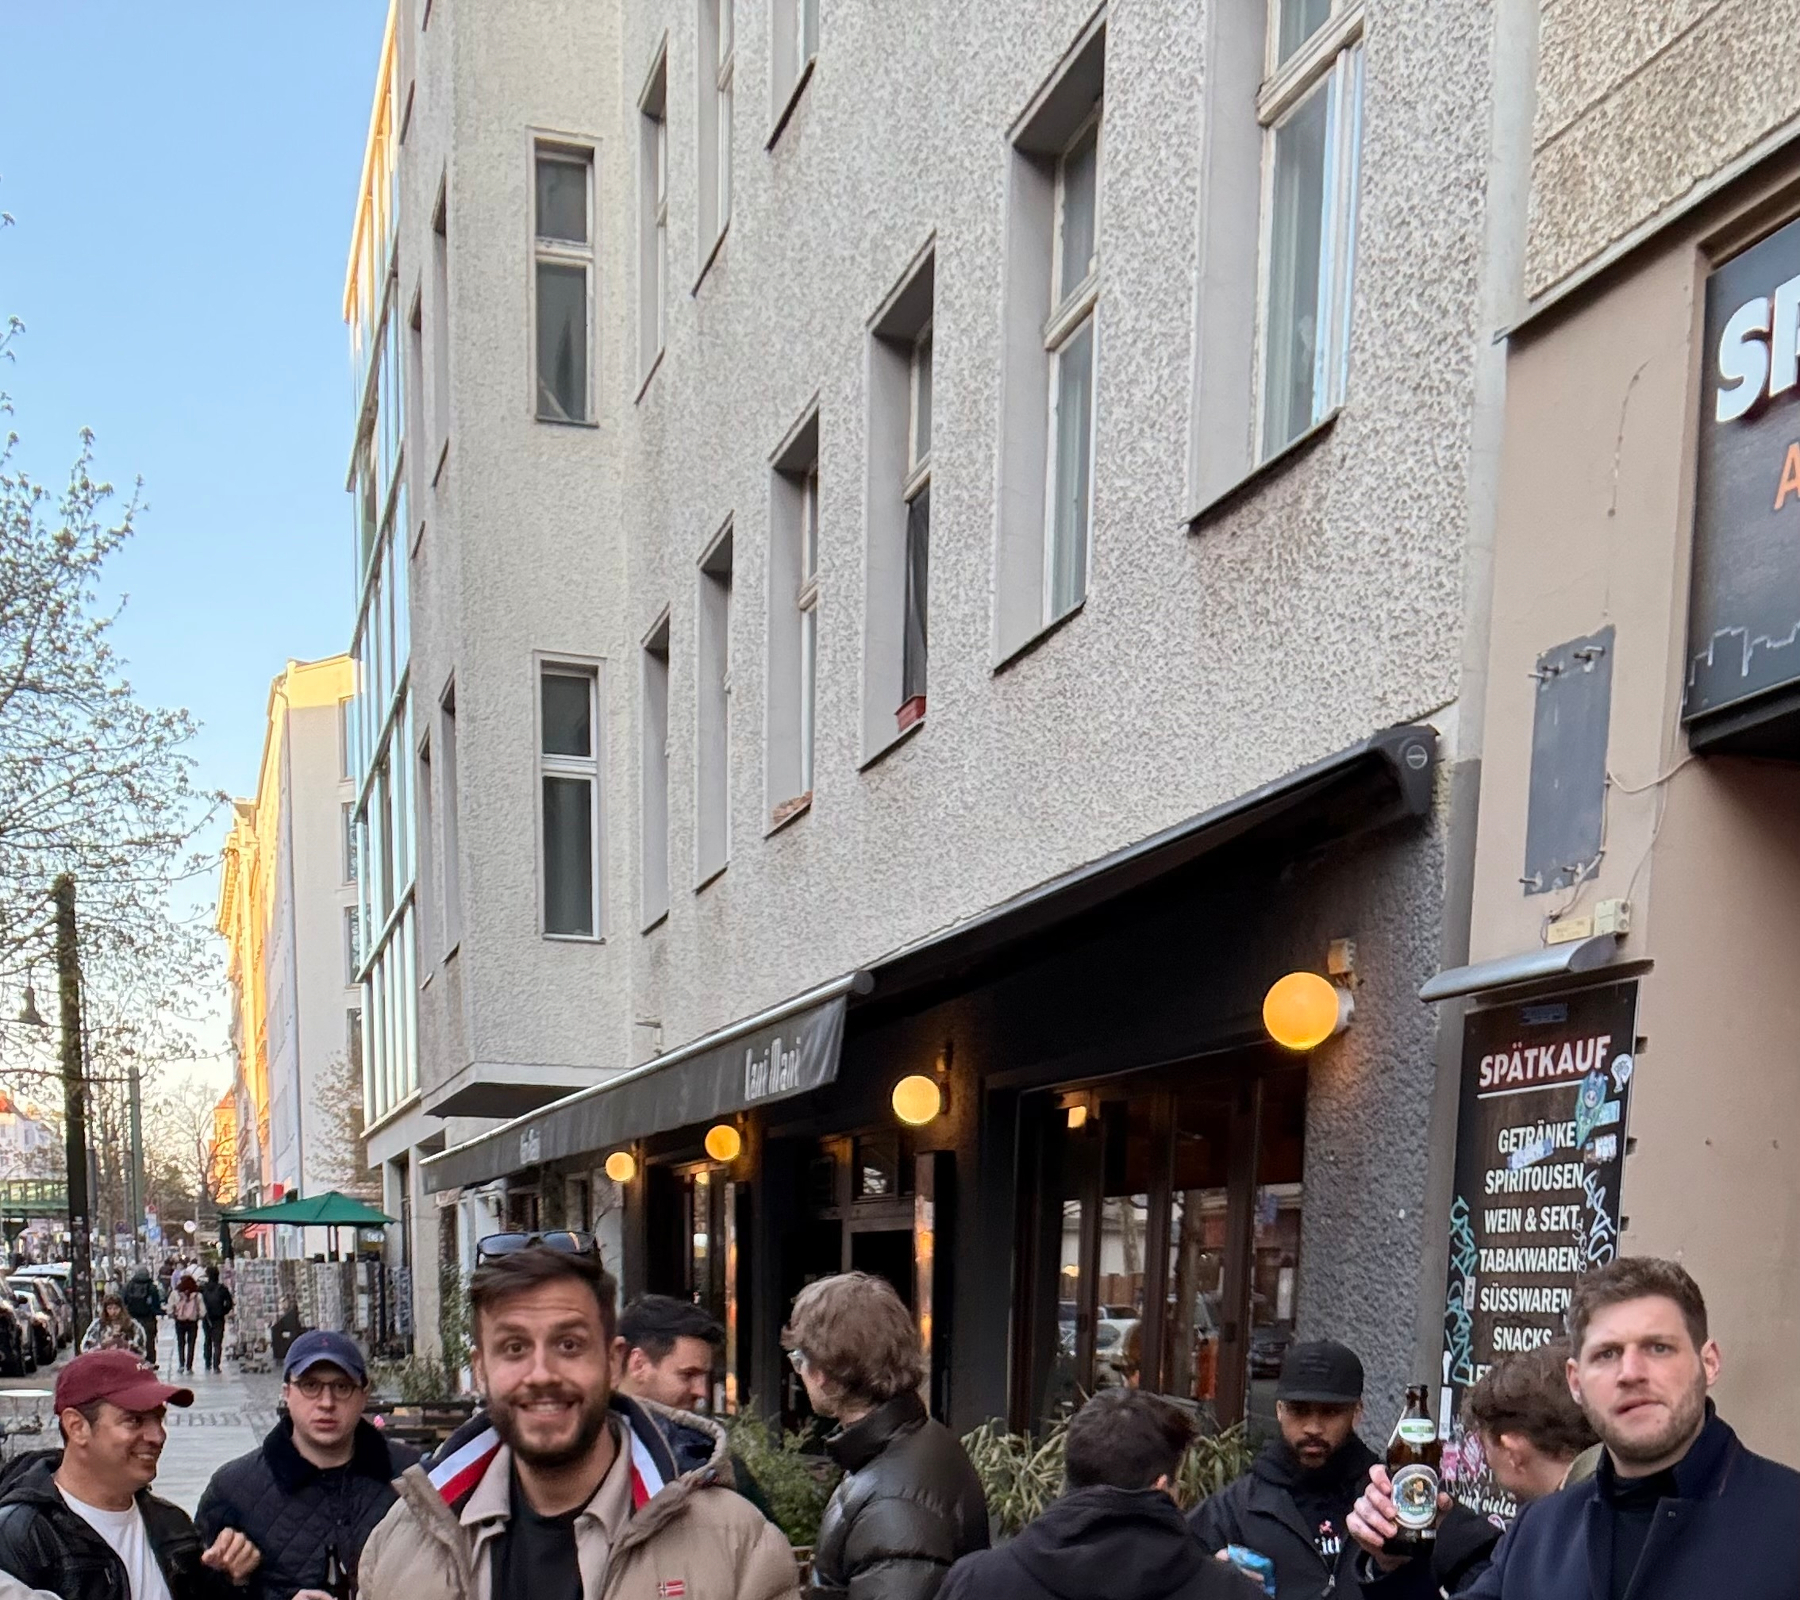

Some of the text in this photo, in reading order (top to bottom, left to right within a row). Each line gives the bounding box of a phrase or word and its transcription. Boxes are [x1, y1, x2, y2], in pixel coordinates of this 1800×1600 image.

[1479, 1034, 1611, 1088] SPÄTKAUF
[1498, 1119, 1577, 1154] GETRÄNKE
[1484, 1162, 1585, 1195] SPIRITOUSEN
[1484, 1204, 1581, 1234] WEIN & SEKT
[1479, 1246, 1580, 1273] TABAKWAREN
[1479, 1282, 1573, 1314] SÜSSWAREN
